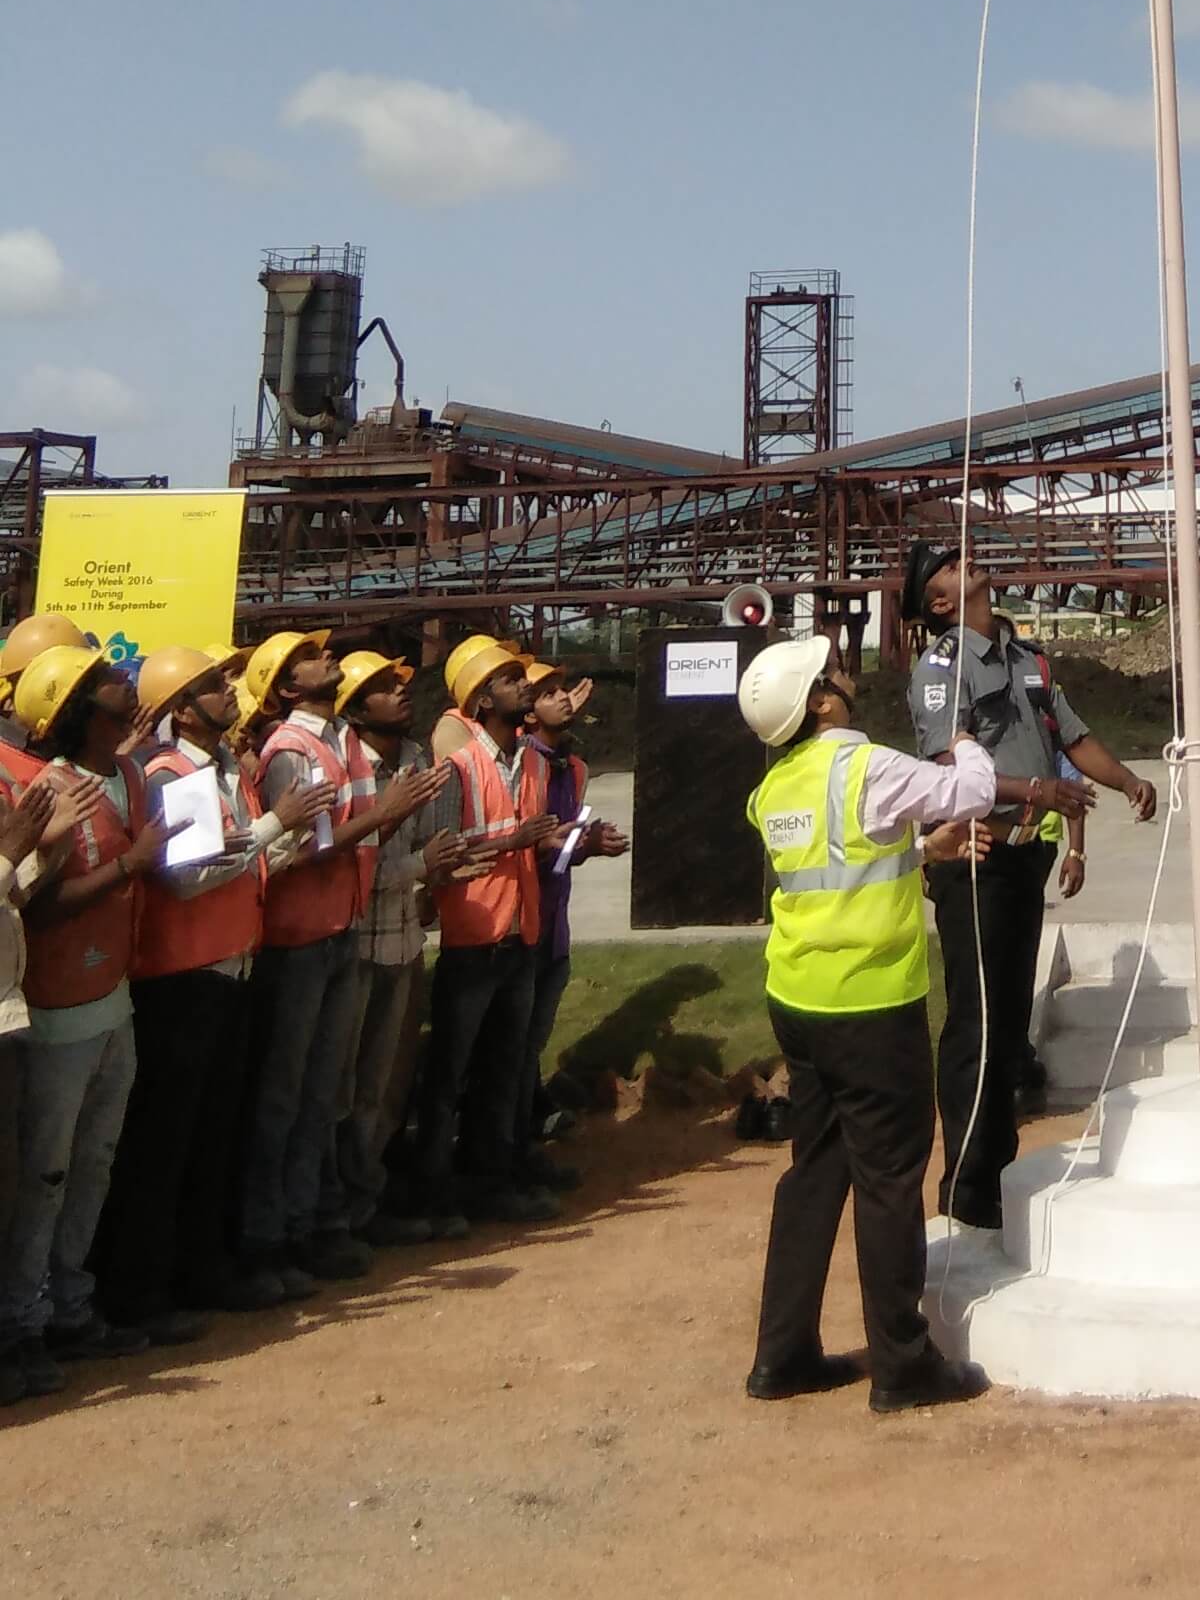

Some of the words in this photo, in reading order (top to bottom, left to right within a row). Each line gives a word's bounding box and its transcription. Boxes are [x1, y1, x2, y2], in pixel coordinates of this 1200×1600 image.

[84, 560, 131, 574] Orient
[64, 577, 95, 588] Safety
[97, 575, 124, 586] Week
[128, 576, 153, 585] 2016
[91, 589, 124, 600] During
[46, 603, 63, 612] 5th
[66, 603, 77, 612] to
[81, 601, 104, 611] 11th
[108, 600, 168, 612] September
[668, 657, 733, 671] ORIENT
[766, 814, 813, 832] ORIENT
